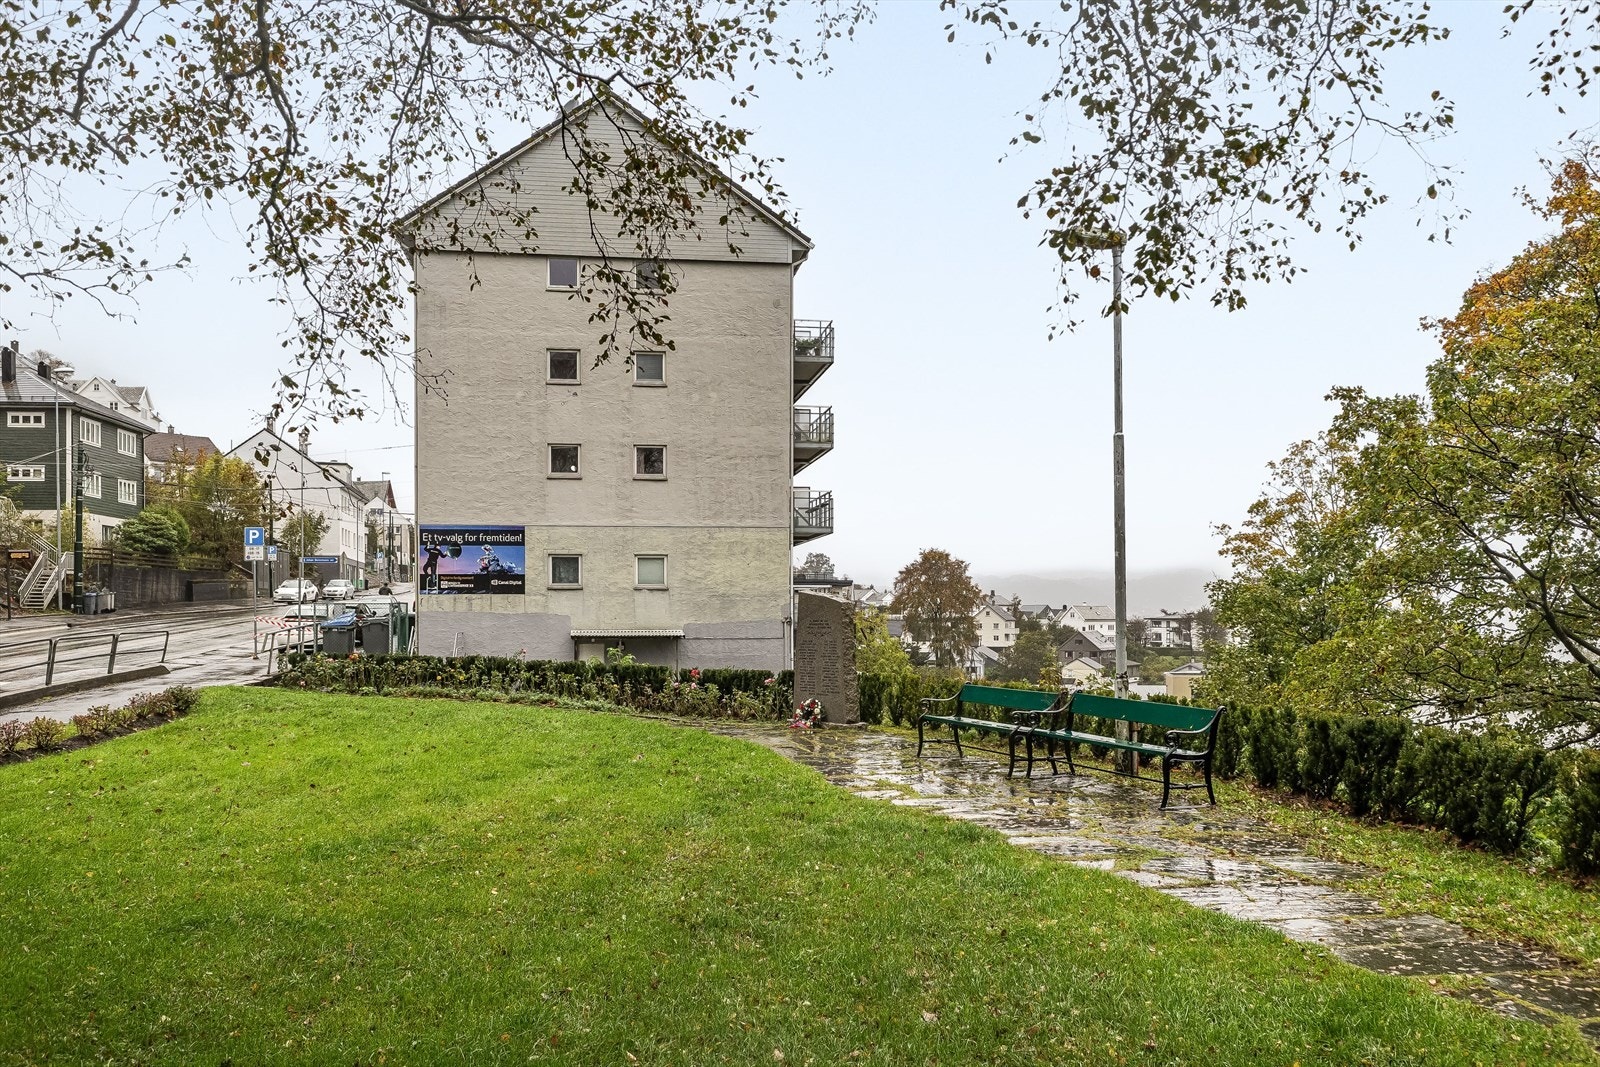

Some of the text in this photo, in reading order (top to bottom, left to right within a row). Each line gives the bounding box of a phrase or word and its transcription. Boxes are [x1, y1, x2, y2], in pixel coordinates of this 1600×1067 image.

[249, 529, 260, 544] P
[422, 532, 522, 544] Et tv-valg for fremtiden!
